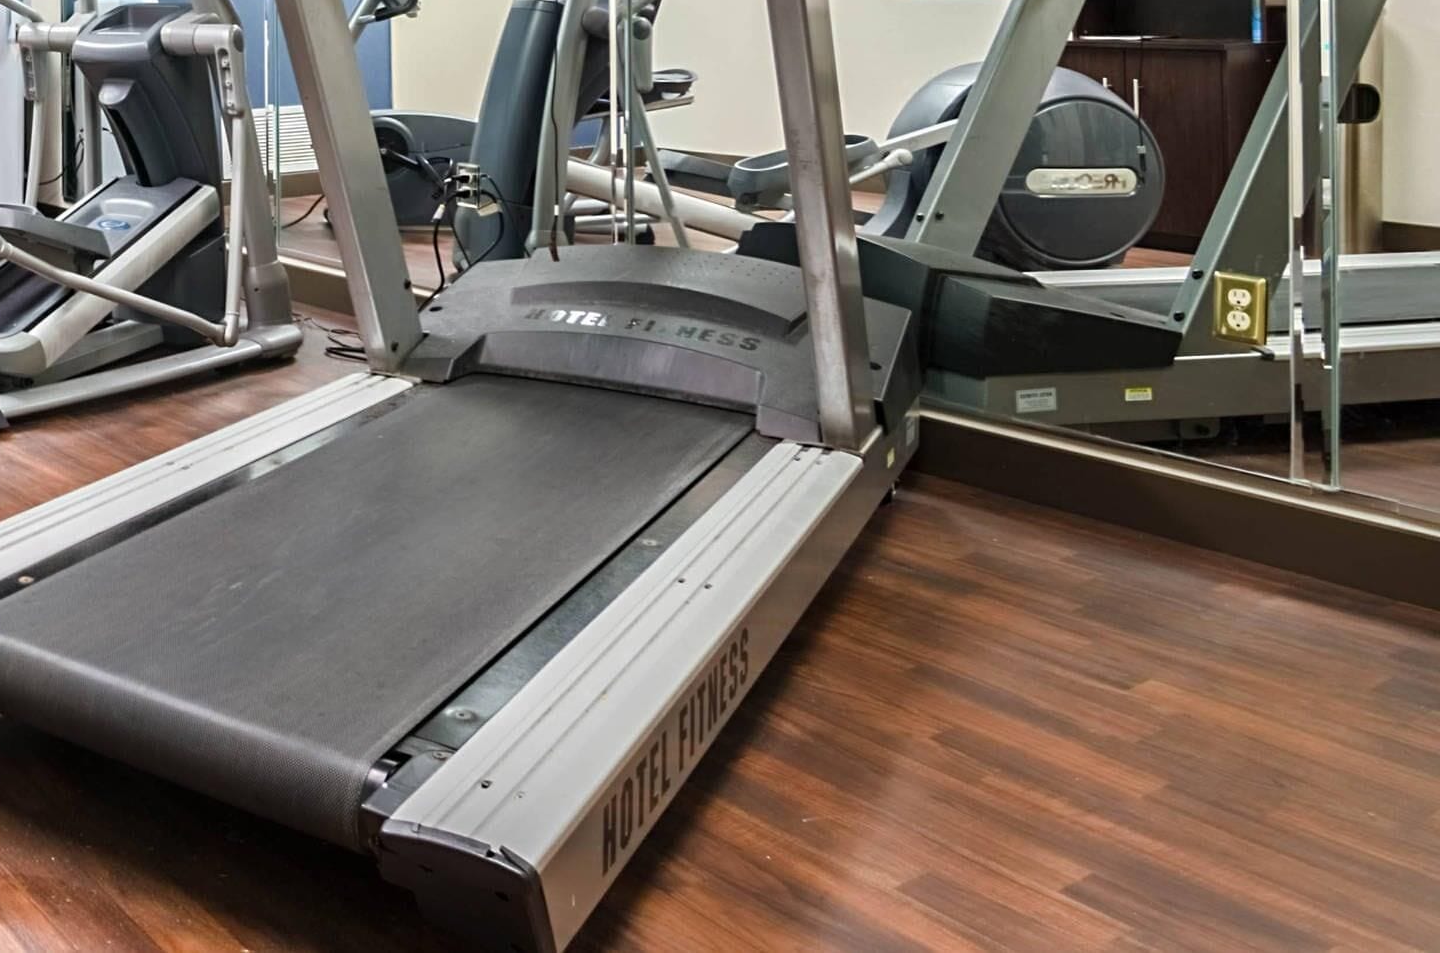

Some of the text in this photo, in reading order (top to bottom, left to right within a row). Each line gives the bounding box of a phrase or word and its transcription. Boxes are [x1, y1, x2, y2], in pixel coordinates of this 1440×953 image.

[624, 317, 761, 351] FINESS
[601, 628, 749, 877] HOTEL FITNESS
